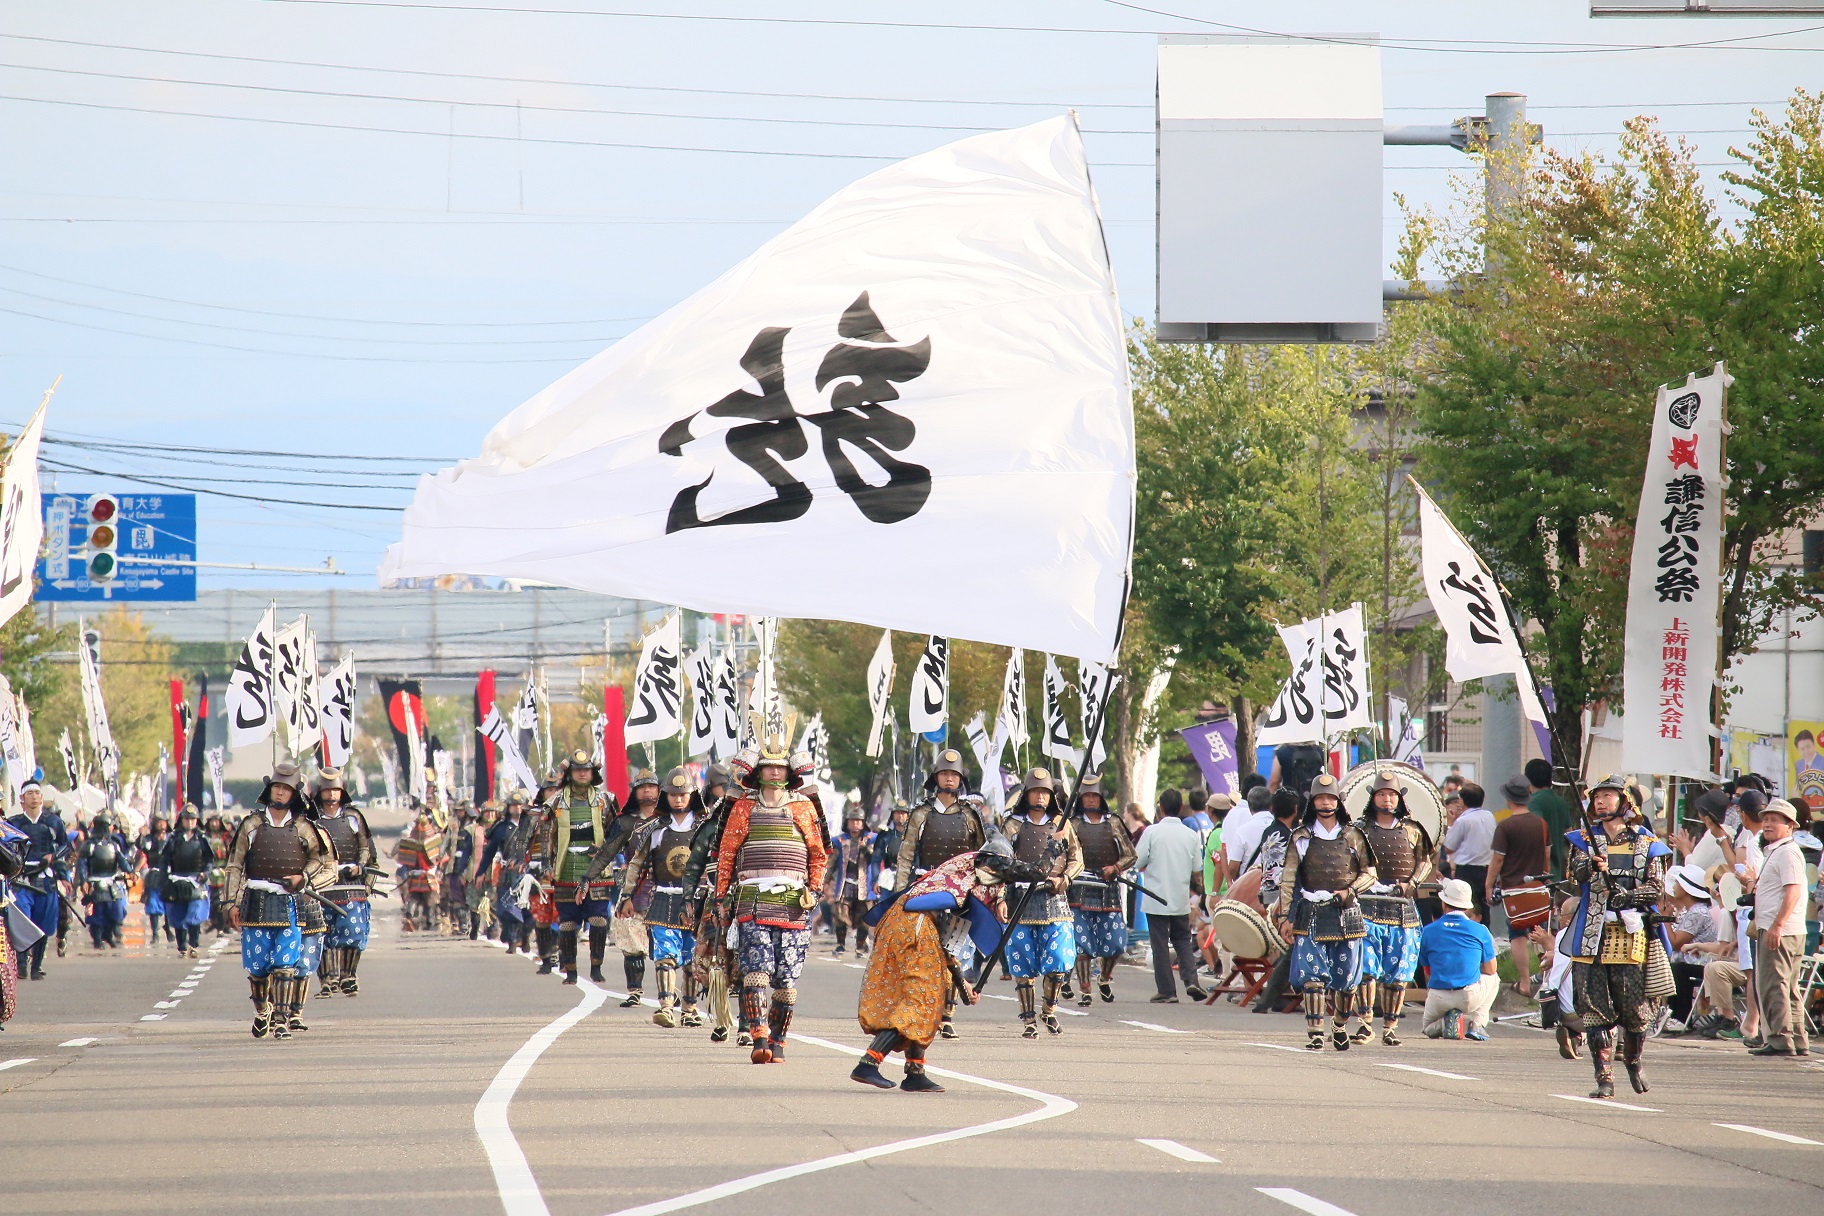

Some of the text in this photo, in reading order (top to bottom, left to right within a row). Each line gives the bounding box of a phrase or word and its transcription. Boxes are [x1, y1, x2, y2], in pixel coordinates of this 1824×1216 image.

[53, 511, 65, 574] 押ボタン式
[1655, 473, 1705, 603] 謙信公祭
[1657, 617, 1690, 740] 上新開発株式会社
